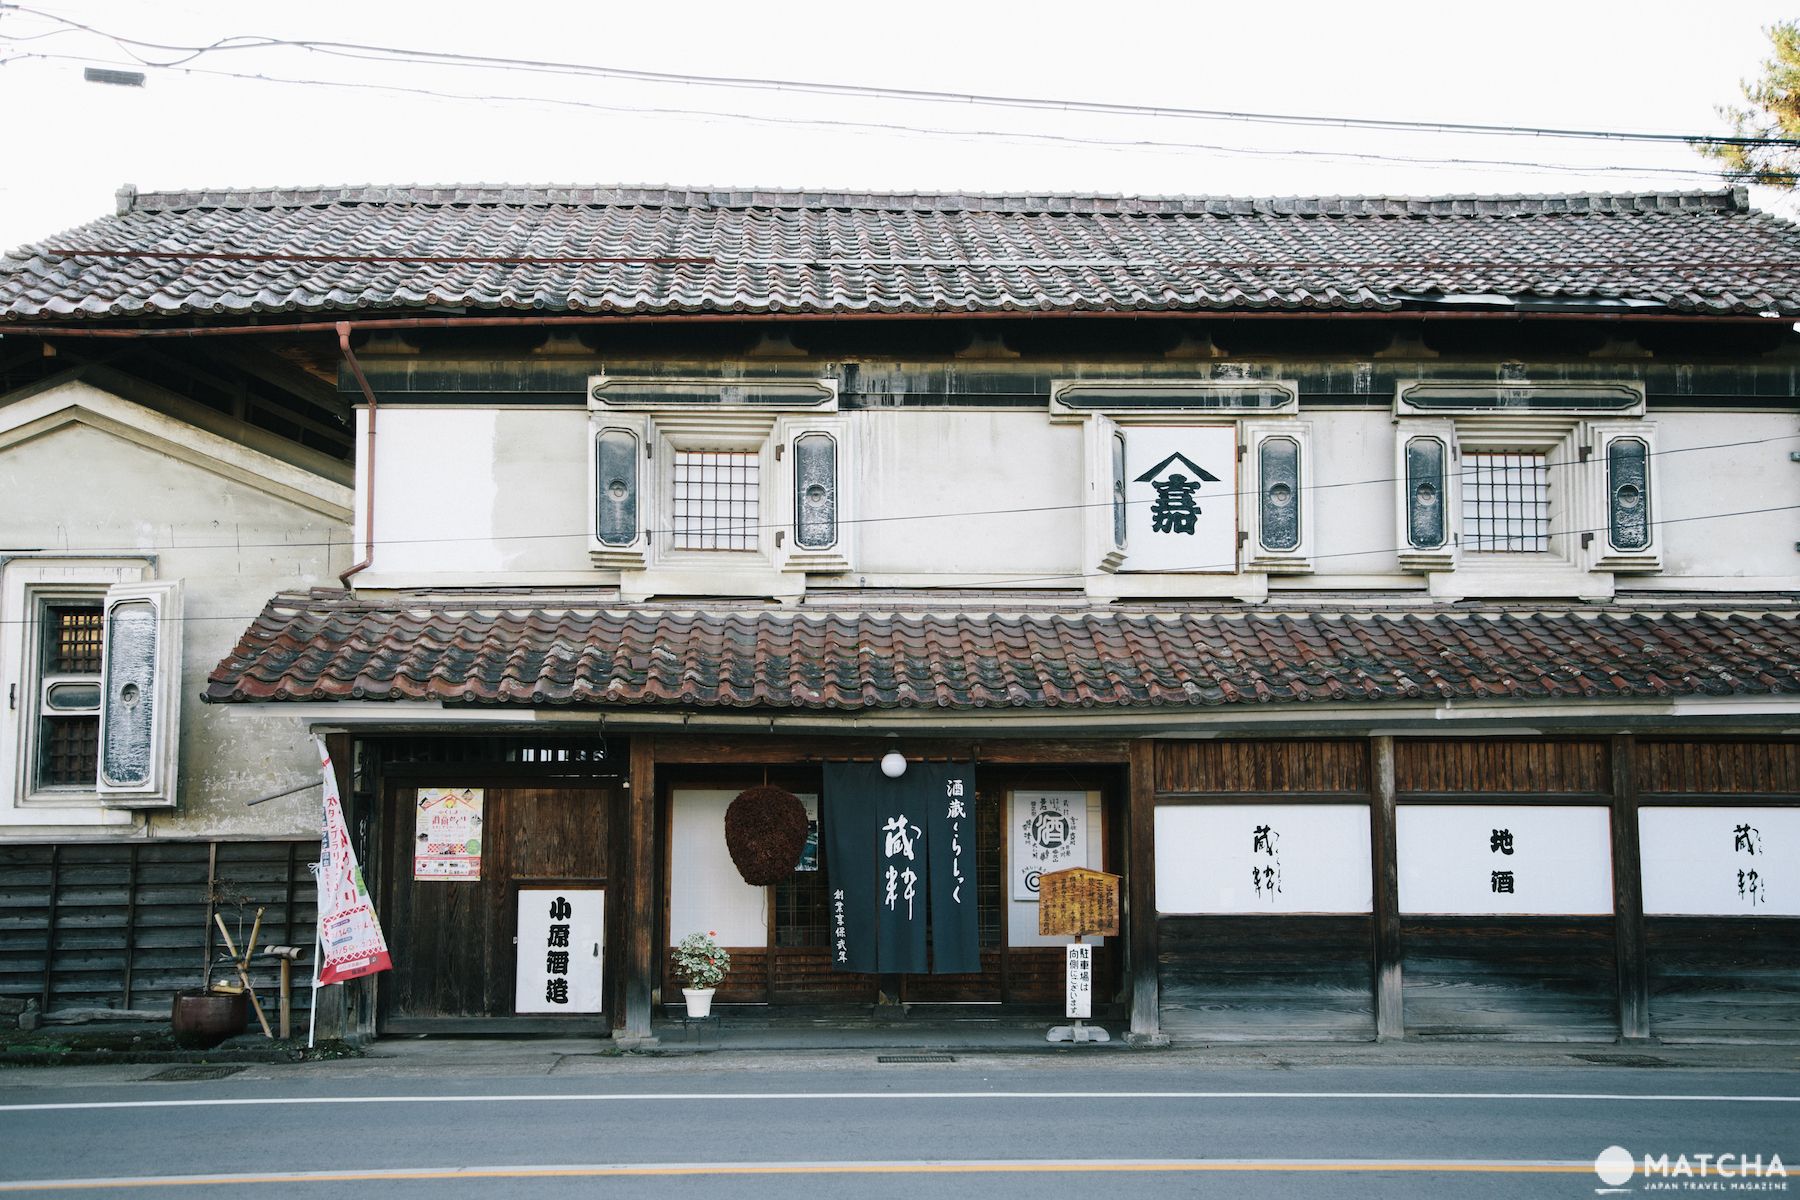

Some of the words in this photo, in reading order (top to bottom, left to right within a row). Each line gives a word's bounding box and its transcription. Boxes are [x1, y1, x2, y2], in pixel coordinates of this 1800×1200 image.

[946, 779, 967, 903] 酒蔵くらしっく
[1034, 813, 1066, 848] 酒
[1490, 828, 1514, 894] 地酒
[546, 896, 571, 1004] 小原酒造
[1080, 948, 1089, 991] 駐車場は
